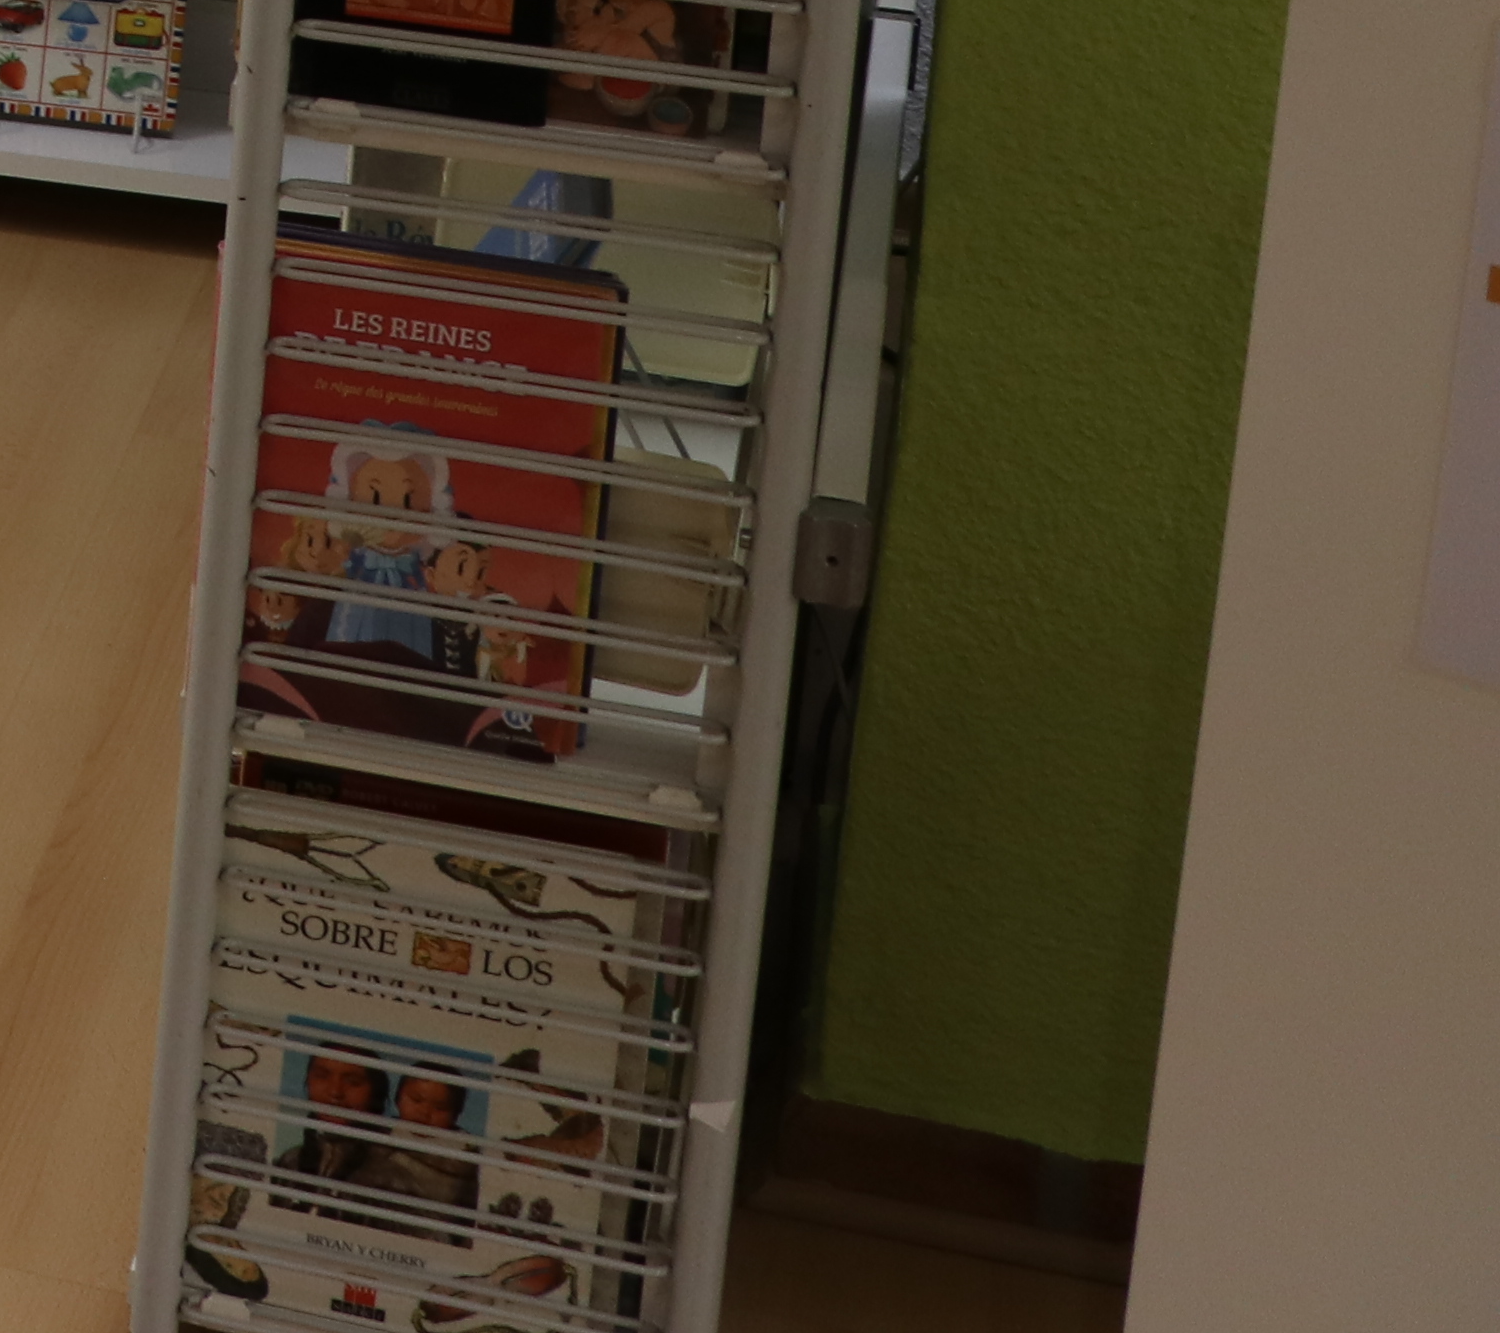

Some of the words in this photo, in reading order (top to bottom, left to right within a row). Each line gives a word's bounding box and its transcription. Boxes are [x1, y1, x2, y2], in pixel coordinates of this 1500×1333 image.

[333, 307, 384, 336] LES
[389, 316, 493, 353] REINES
[280, 910, 399, 957] SOBRE
[481, 948, 555, 986] LOS
[306, 1232, 352, 1253] BRYAN
[357, 1243, 368, 1256] Y
[369, 1246, 427, 1269] CHERRY
